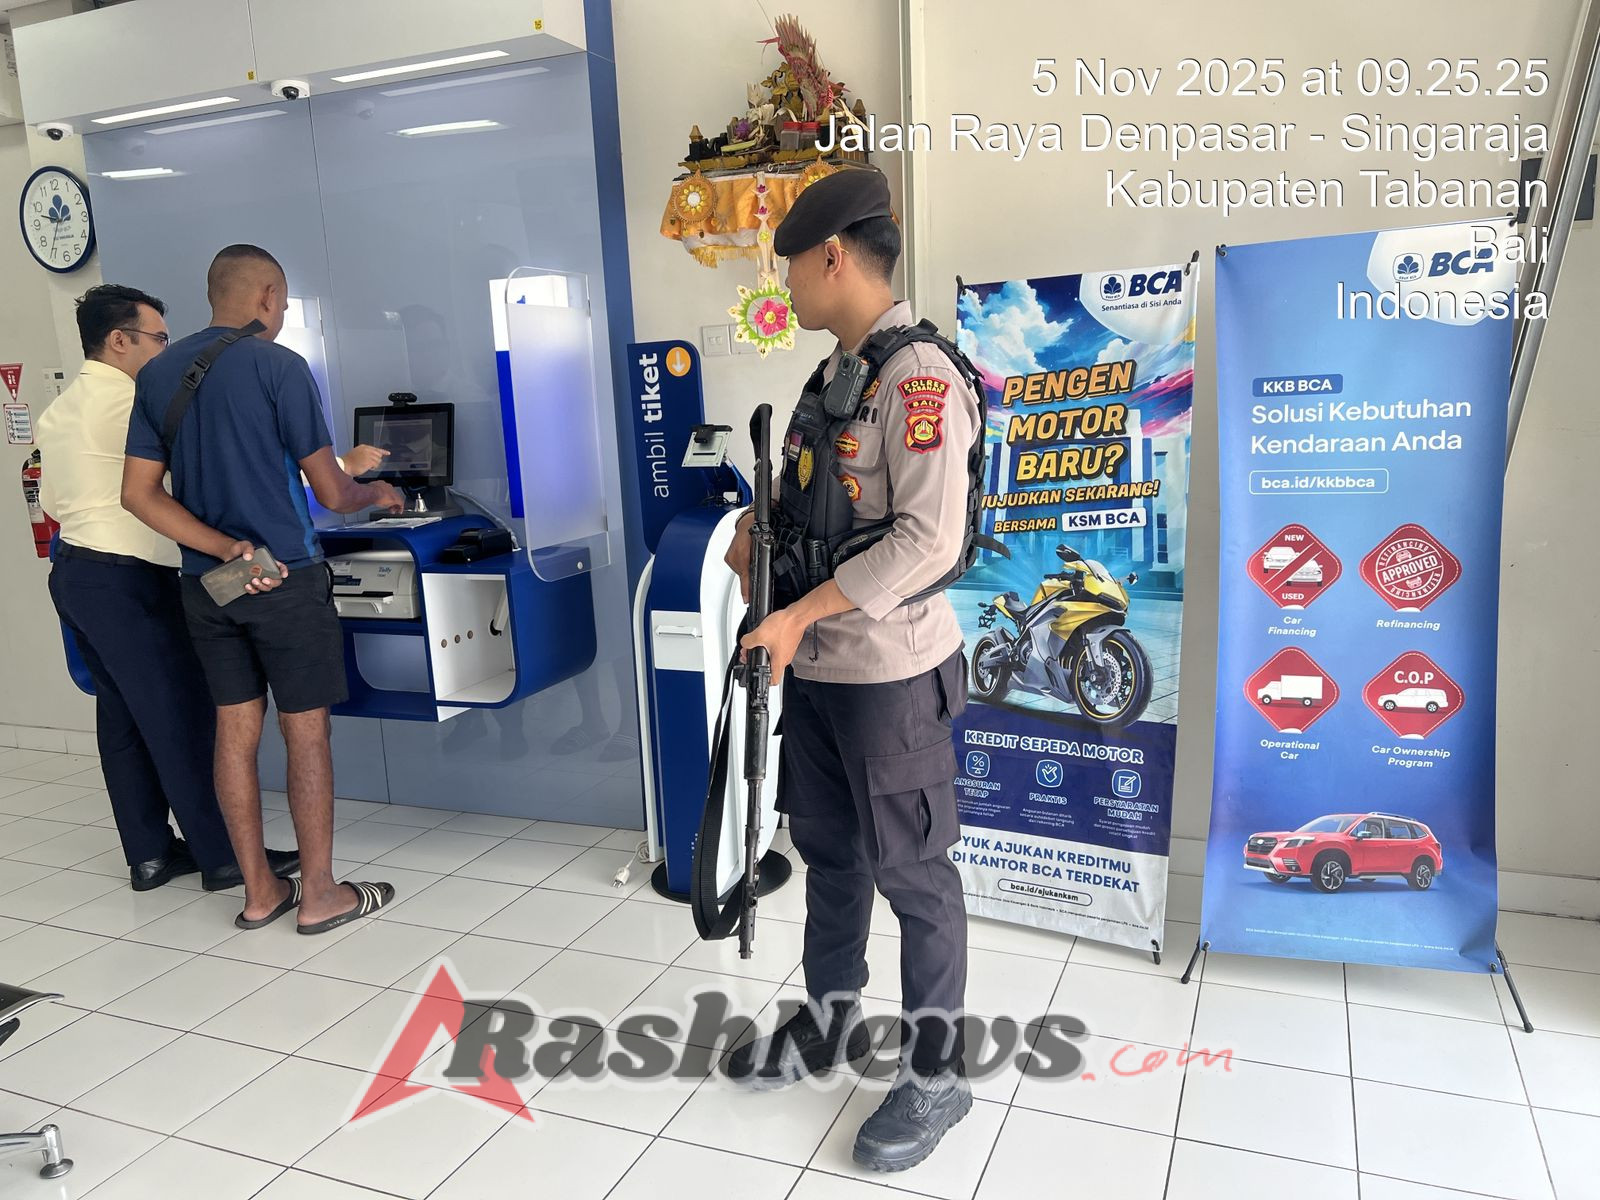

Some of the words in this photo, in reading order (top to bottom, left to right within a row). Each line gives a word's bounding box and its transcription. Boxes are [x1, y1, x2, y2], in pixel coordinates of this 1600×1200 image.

[40, 186, 47, 197] 11
[50, 179, 59, 191] 12
[65, 182, 70, 192] 1
[74, 193, 82, 205] 2
[33, 201, 42, 213] 10
[80, 211, 88, 223] 3
[33, 219, 41, 231] 9
[80, 229, 87, 240] 4
[39, 236, 48, 247] 8
[63, 251, 71, 262] 6
[74, 244, 81, 256] 5
[1428, 250, 1494, 277] BCA
[1128, 270, 1182, 297] BCA
[1101, 302, 1139, 312] Senantiasa
[1141, 301, 1148, 310] di
[1149, 300, 1161, 309] Sisi
[1163, 298, 1182, 307] Anda
[638, 352, 663, 424] tiket
[903, 379, 946, 392] POLRES
[908, 385, 943, 394] TABANAN
[1003, 361, 1134, 407] PENGEN
[1263, 380, 1295, 393] KKB
[1298, 378, 1332, 392] BCA
[912, 400, 938, 408] BALI
[1251, 402, 1323, 424] Solusi
[1329, 399, 1471, 422] Kebutuhan
[1009, 405, 1125, 443] MOTOR
[1251, 434, 1386, 455] Kendaraan
[1391, 429, 1462, 451] Anda
[644, 431, 670, 498] ambil
[1016, 445, 1124, 481] BARU?
[1261, 476, 1375, 490] bca.id/kkbbca
[1065, 480, 1161, 503] SEKARANG!
[994, 518, 1056, 533] BERSAMA
[1068, 514, 1101, 527] KSM
[1106, 512, 1140, 525] BCA
[1284, 534, 1304, 542] NEW
[1381, 553, 1439, 584] APPROVED
[1281, 592, 1304, 601] USED
[1283, 616, 1302, 625] Car
[1376, 619, 1441, 631] Refinancing
[1267, 626, 1317, 638] Financing
[1394, 671, 1434, 685] C.O.P
[965, 730, 1019, 749] KREDIT
[1020, 736, 1081, 757] SEPEDA
[1082, 744, 1144, 765] MOTOR
[1260, 739, 1320, 751] Operational
[1280, 751, 1299, 760] Car
[1371, 745, 1391, 755] Car
[1393, 747, 1451, 759] Ownership
[1387, 757, 1433, 768] Program
[954, 777, 1001, 791] ANGSURAN
[964, 788, 989, 799] TETAP
[1029, 792, 1067, 805] PRAKTIS
[1093, 797, 1159, 813] PERSYARATAN
[1107, 809, 1142, 821] MUDAH
[962, 835, 990, 850] YUK
[993, 841, 1053, 860] AJUKAN
[1057, 851, 1131, 874] KREDITMU
[952, 850, 966, 862] DI
[969, 854, 1028, 874] KANTOR
[1031, 865, 1062, 880] BCA
[1066, 869, 1140, 893] TERDEKAT
[1010, 882, 1079, 902] bca.id/ajukanksm
